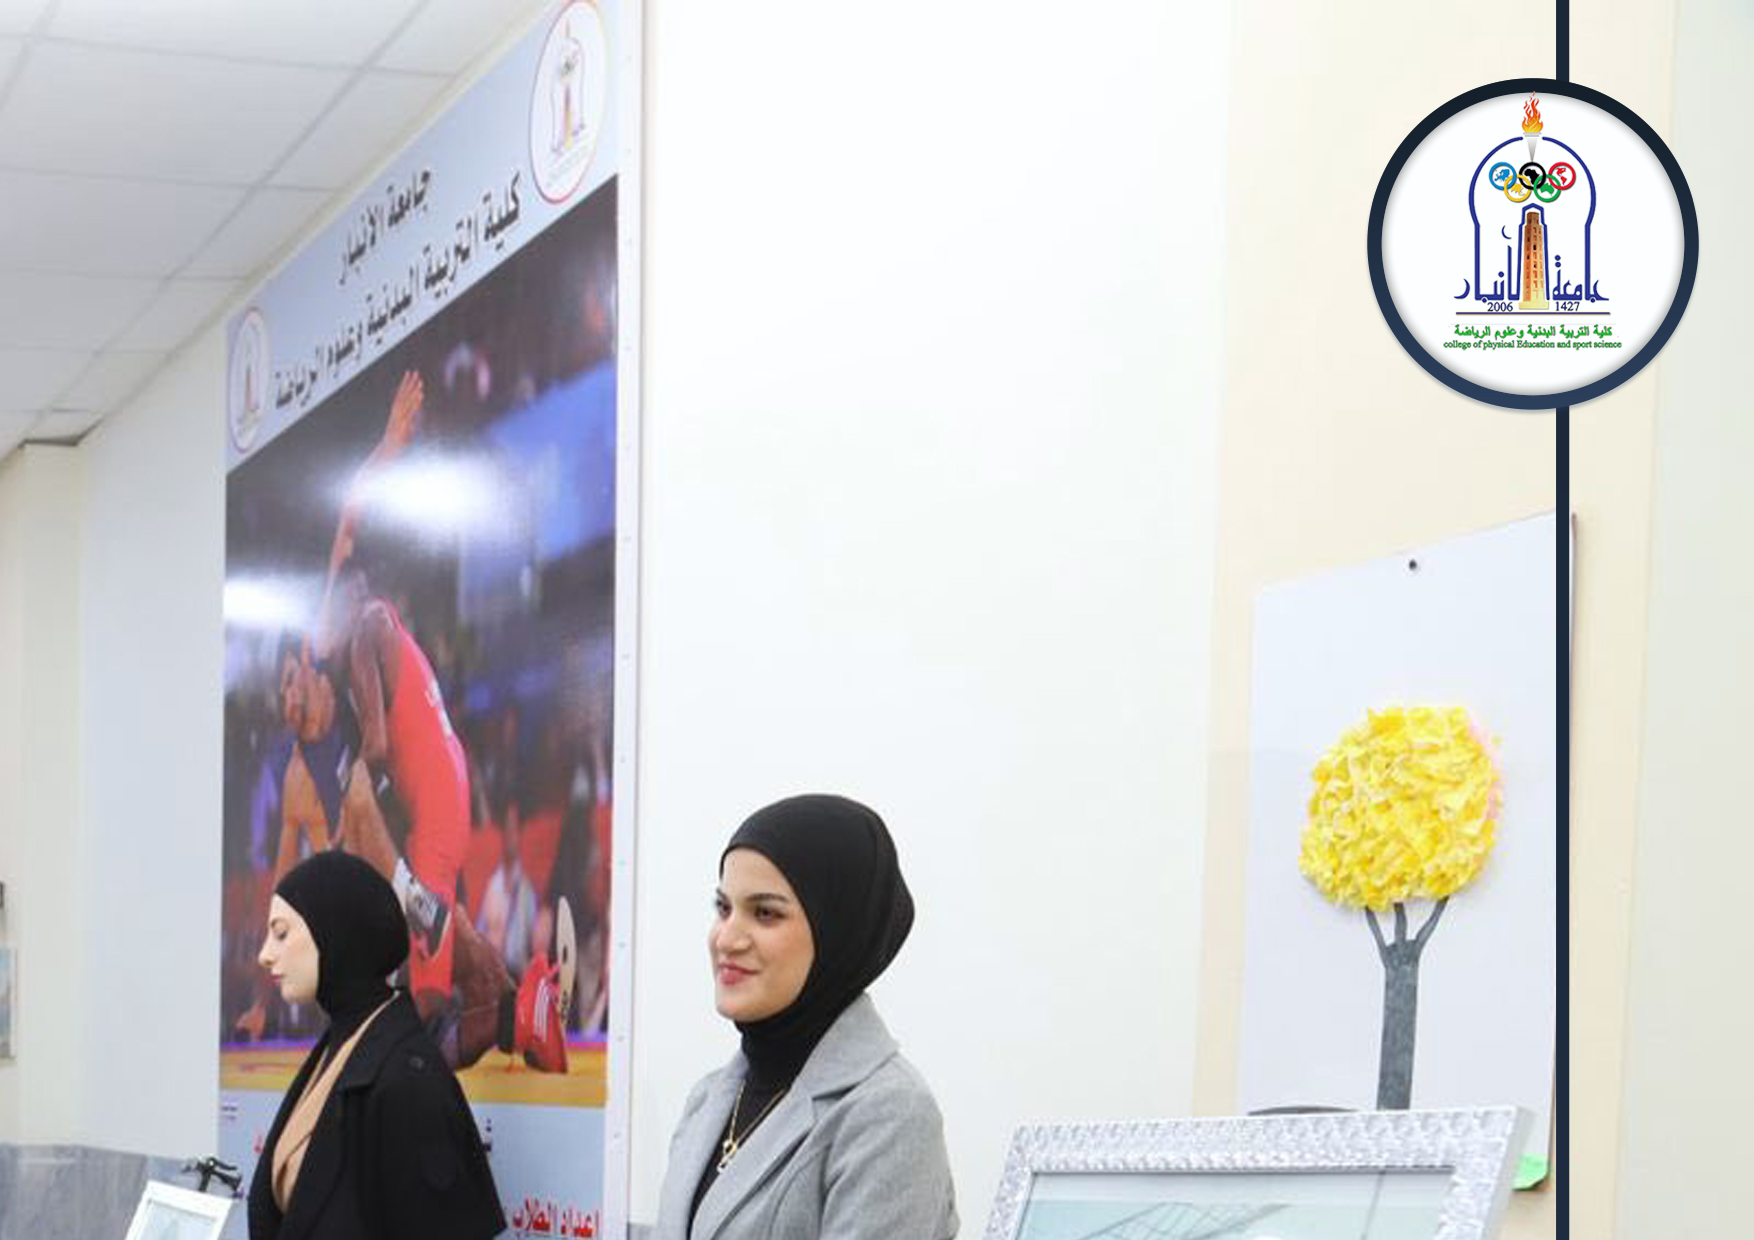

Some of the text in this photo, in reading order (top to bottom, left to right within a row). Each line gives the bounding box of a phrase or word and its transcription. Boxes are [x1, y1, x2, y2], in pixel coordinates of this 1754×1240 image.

[386, 170, 431, 228] جامعة
[482, 171, 521, 251] كلية
[423, 208, 480, 299] التربية
[367, 263, 420, 346] البدنية
[275, 345, 326, 408] الرياضة
